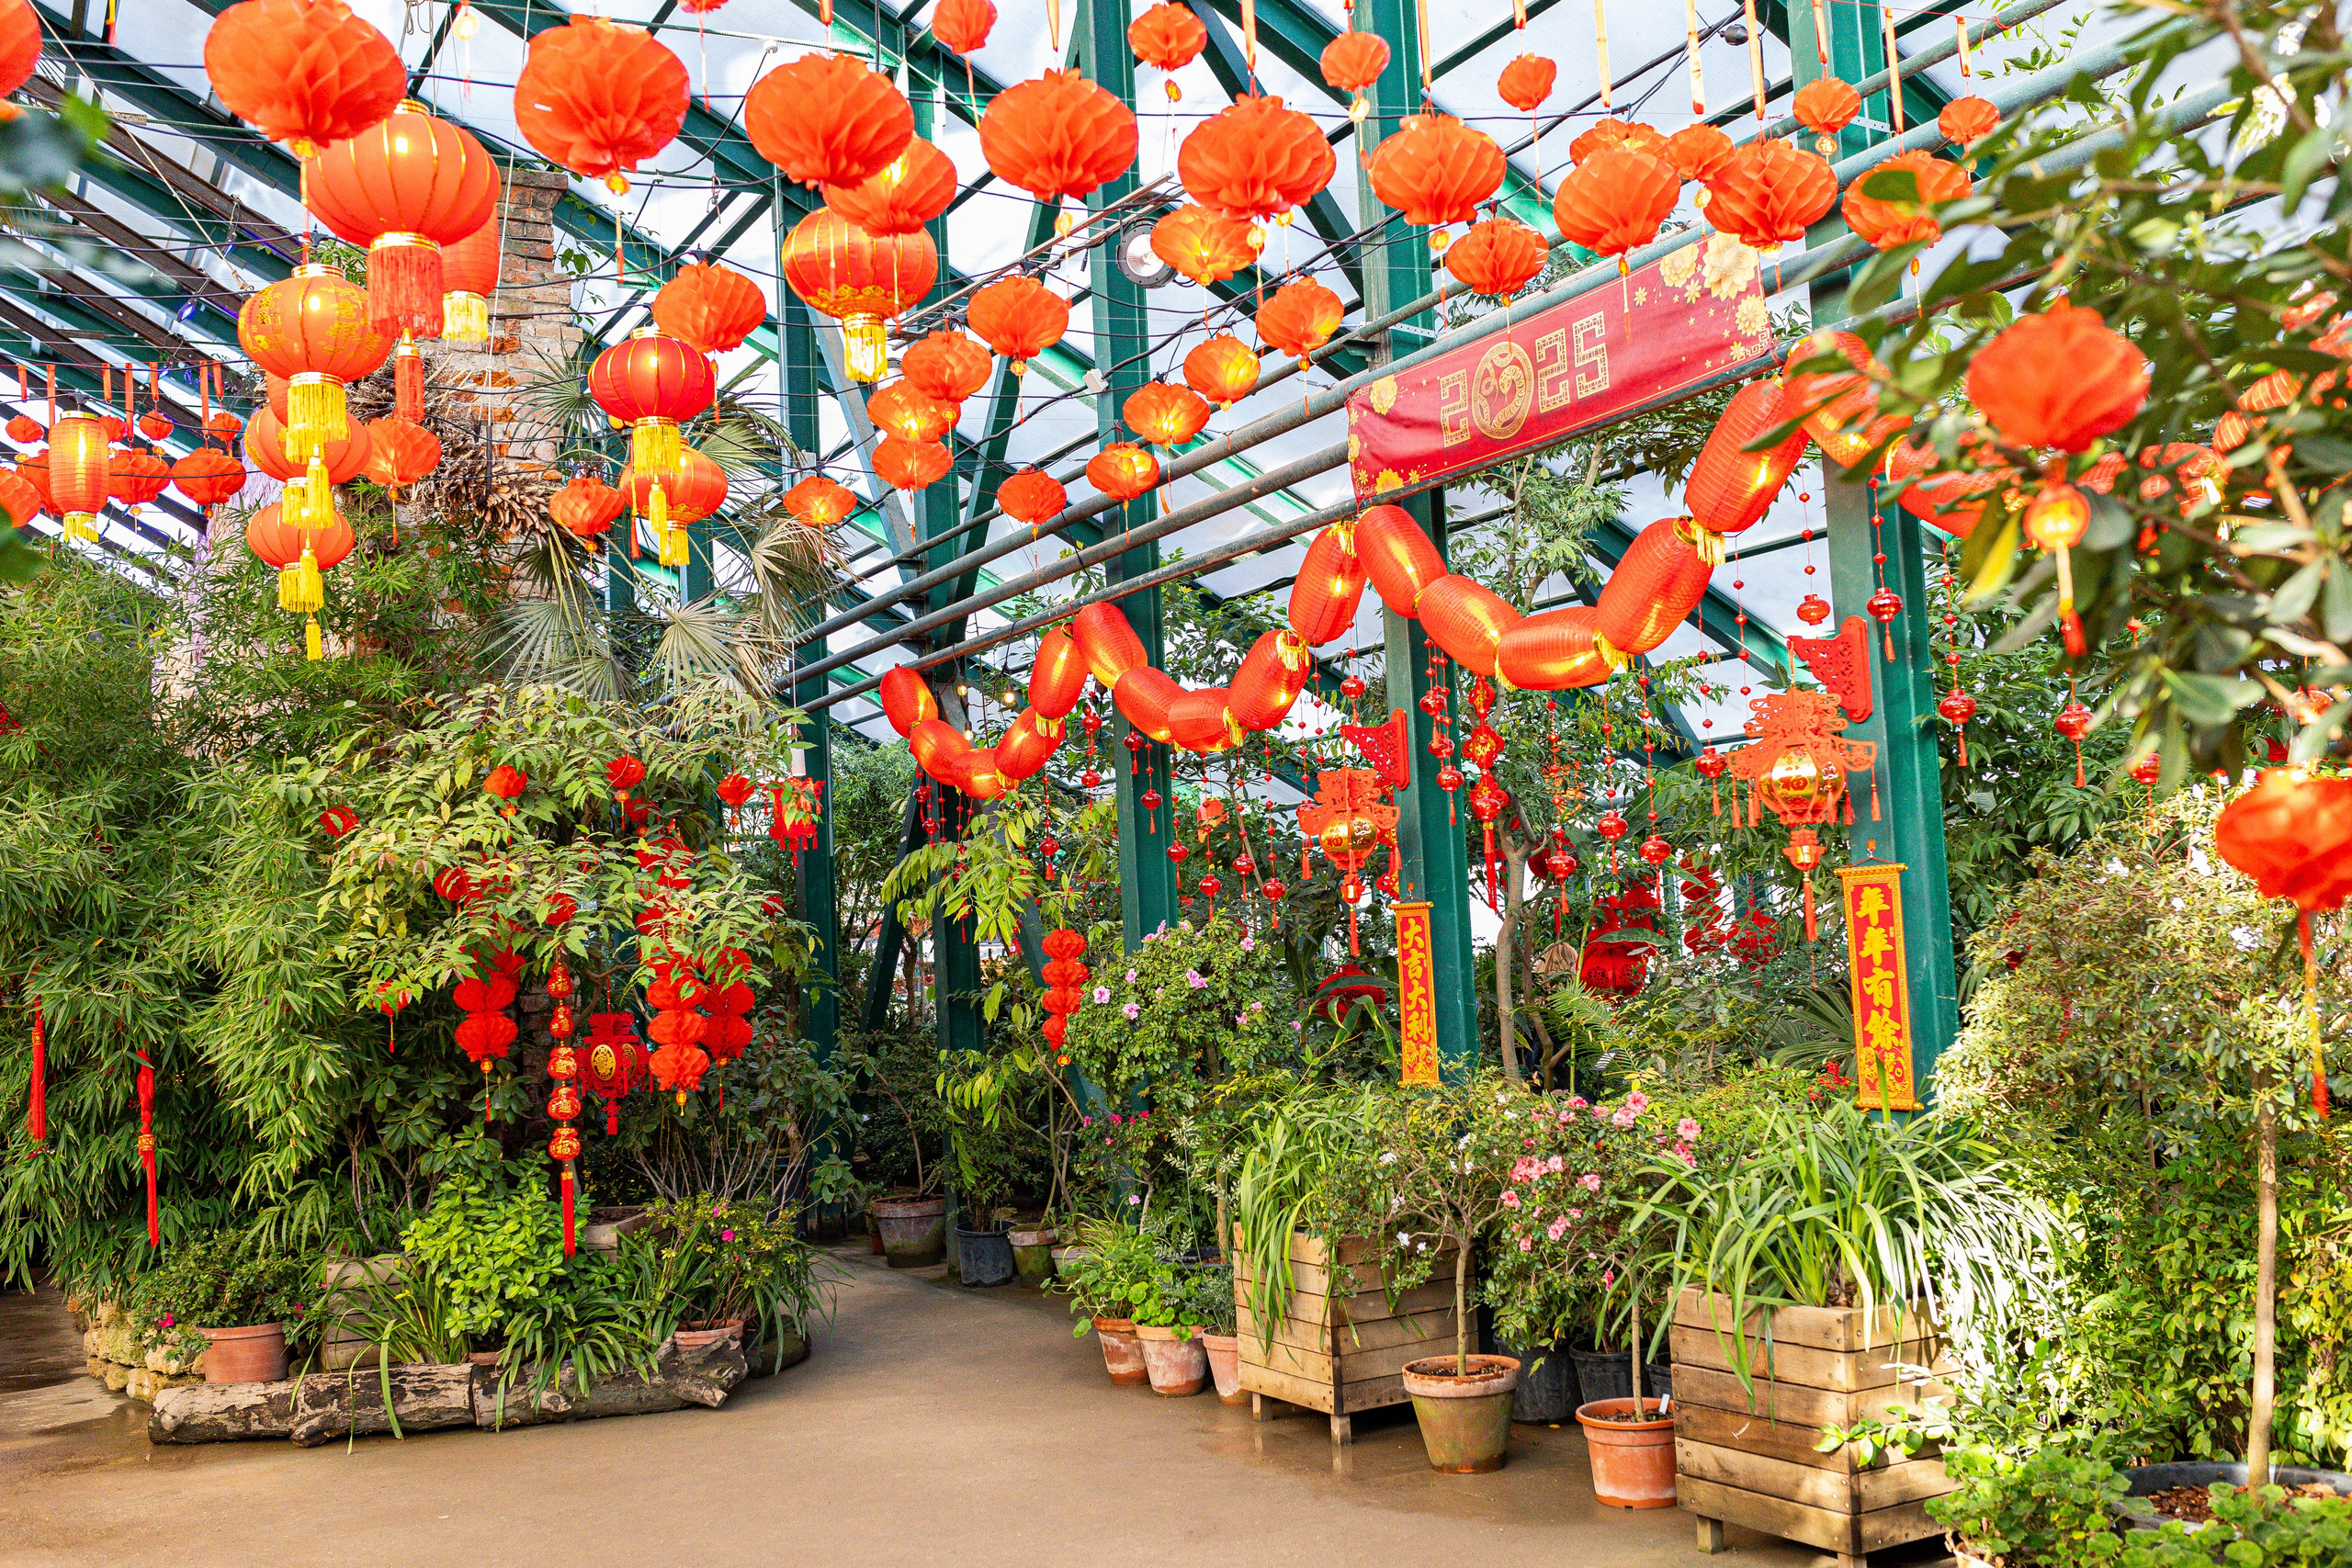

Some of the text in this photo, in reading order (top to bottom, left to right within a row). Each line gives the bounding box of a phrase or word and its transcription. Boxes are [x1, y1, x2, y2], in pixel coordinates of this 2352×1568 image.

[1821, 138, 1833, 152] 福
[1440, 310, 1610, 447] 2025
[1403, 918, 1429, 1042] 大吉大利
[1855, 886, 1902, 1051] 年年有餘
[556, 1139, 571, 1155] 福
